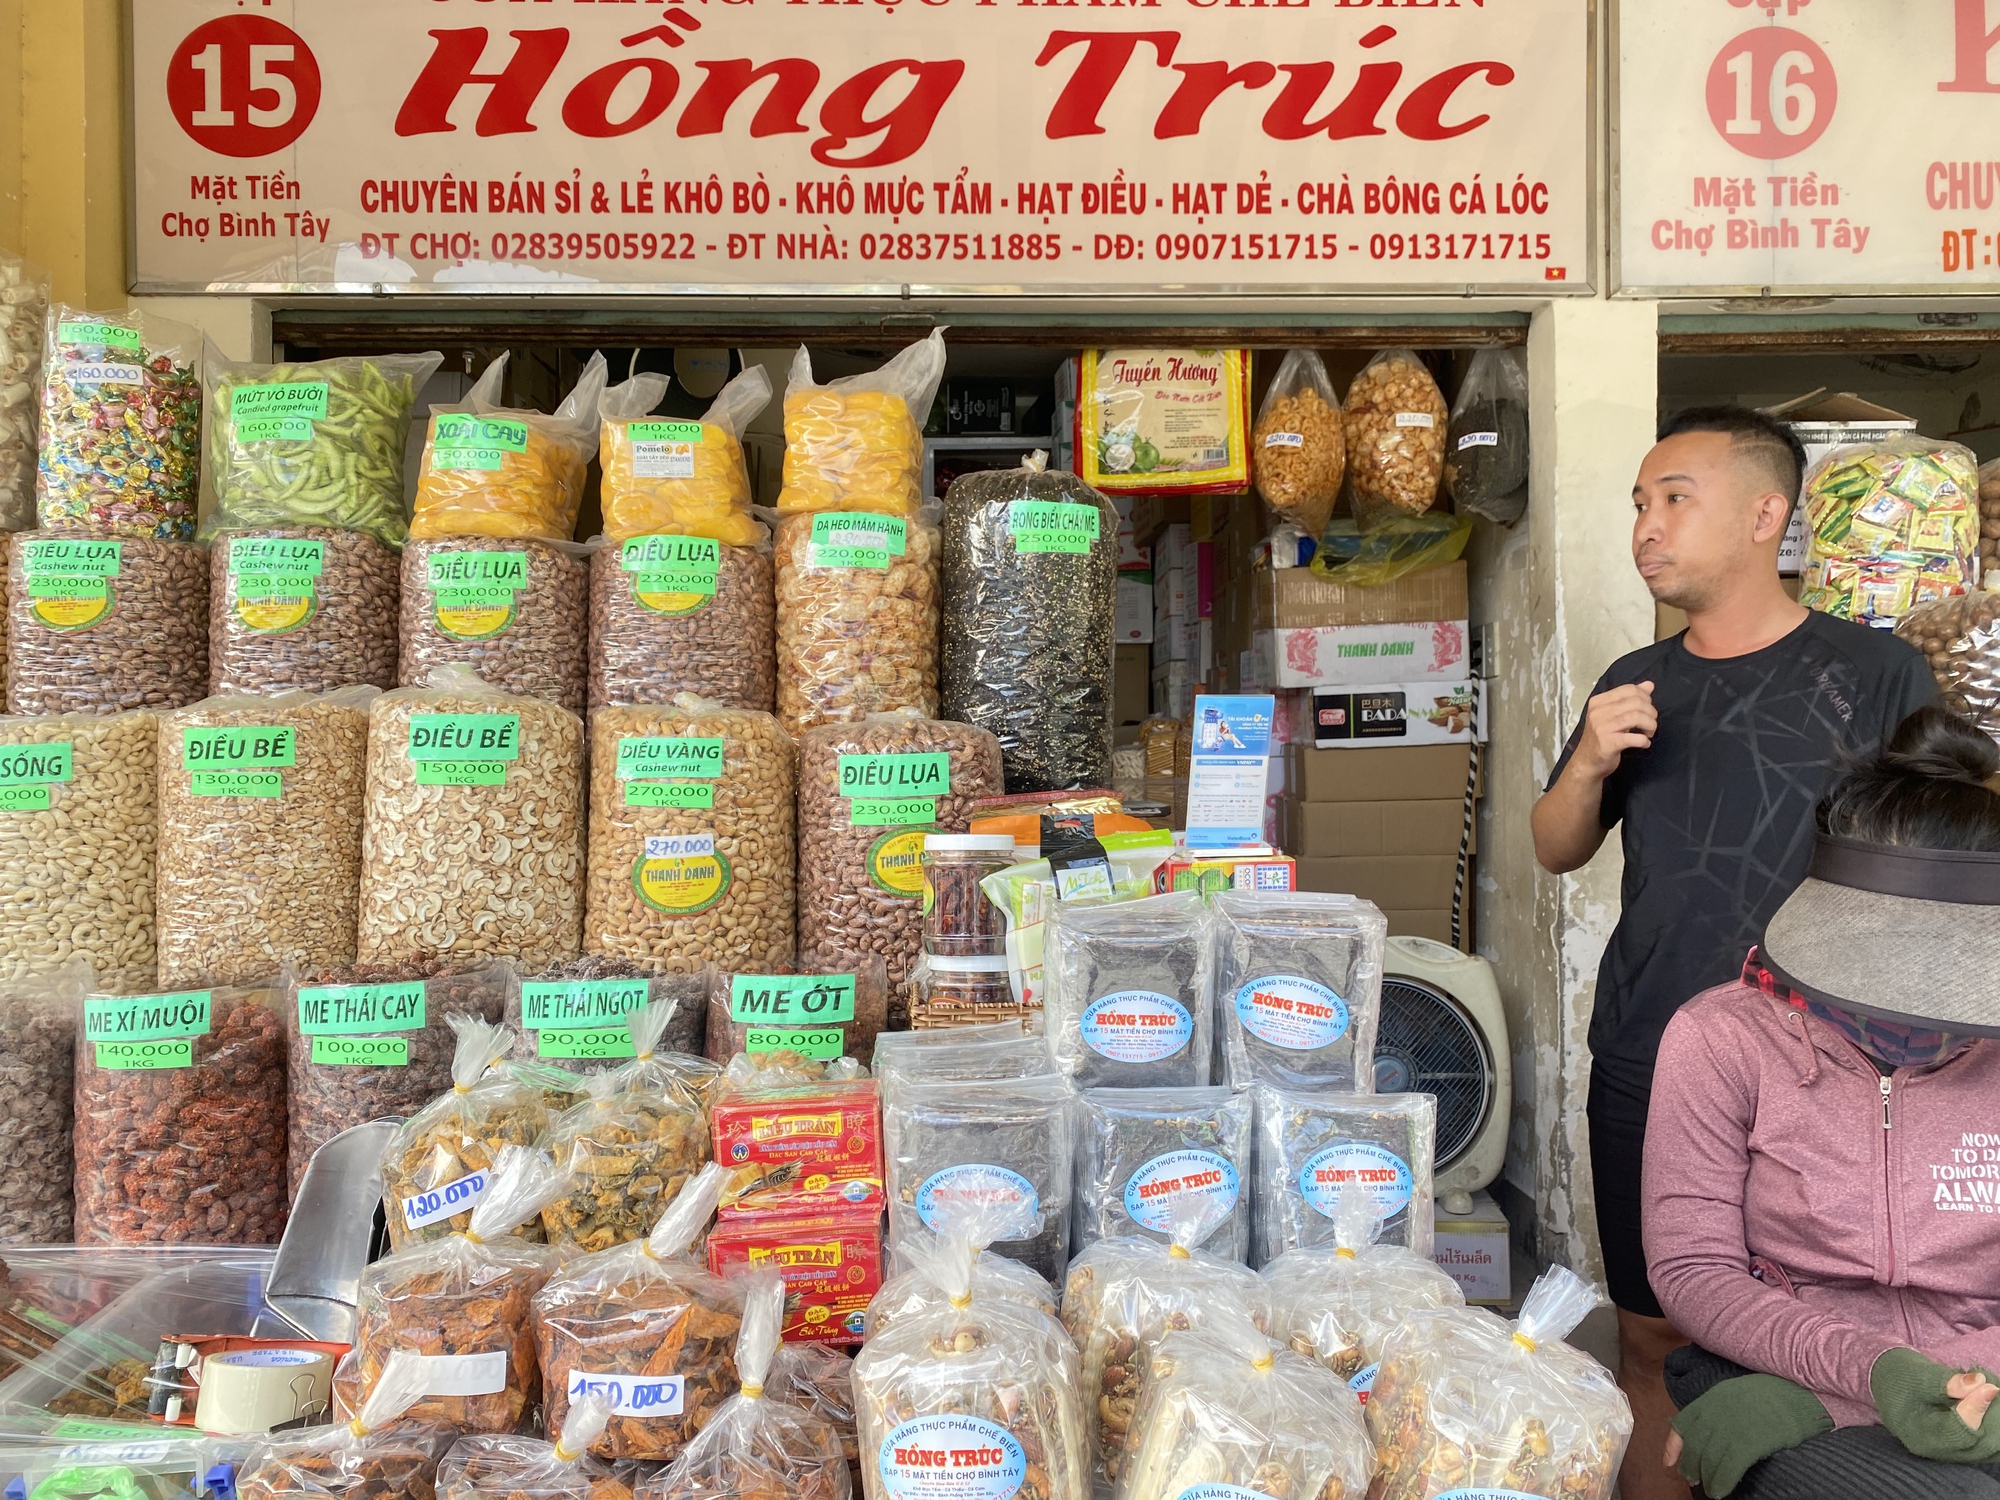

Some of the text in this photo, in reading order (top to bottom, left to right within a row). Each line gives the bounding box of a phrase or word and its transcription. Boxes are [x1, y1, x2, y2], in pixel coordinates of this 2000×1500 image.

[191, 44, 295, 127] 15
[394, 8, 1515, 168] Hồng Trúc
[1726, 50, 1817, 136] 16
[191, 169, 300, 205] Mặt Tiền
[360, 165, 1549, 224] CHUYÊN BÁN SỈ & LẺ KHÔ BÒ KHÔ MỰC TẨM HẠT ĐIỀU HẠT DẺ CHÀ BÔNG CÁ LÓC
[1693, 172, 1839, 215] Mặt Tiền
[161, 210, 330, 244] Chợ Bình Tây
[360, 224, 1551, 266] ĐT CHỢ: 02839505922 ĐT NHÀ: 02837511885 DĐ: 0907151715 0913171715
[1651, 217, 1870, 257] Chợ Bình Tây
[63, 324, 138, 341] 160.000
[78, 367, 139, 381] 160.000
[1167, 357, 1219, 387] Hương
[235, 387, 323, 404] MỨT VỎ BƯỞI
[237, 403, 318, 415] Candied grapefruit
[240, 421, 307, 434] 160.000
[631, 423, 700, 434] 140.000
[636, 445, 670, 453] Pomelo
[816, 519, 829, 531] DA
[830, 519, 850, 531] HEO
[877, 520, 904, 537] HÀNH
[1012, 511, 1039, 529] RONG
[1020, 534, 1087, 544] 250.000
[75, 546, 117, 562] LỤA
[281, 546, 320, 562] LỤA
[626, 538, 716, 566] ĐIỀU LỤA
[817, 549, 887, 561] 220.000
[34, 562, 105, 571] Cashew nut
[239, 560, 309, 571] Cashew nut
[432, 556, 522, 583] ĐIỀU LỤA
[32, 578, 104, 588] 230.000
[240, 578, 312, 588] 230.000
[641, 574, 713, 585] 220.000
[263, 588, 287, 596] 1KG
[439, 587, 511, 598] 230.000
[1337, 641, 1415, 658] THANH DANH
[413, 720, 515, 749] ĐIỀU BỂ
[189, 730, 289, 760] ĐIỀU BỂ
[620, 738, 720, 760] ĐIỀU VÀNG
[1, 750, 63, 778] SỐNG
[420, 762, 504, 774] 150.000
[680, 763, 701, 773] nut
[195, 774, 278, 786] 130.000
[447, 776, 475, 784] 1KG
[843, 759, 940, 792] ĐIỀU LỤA
[220, 787, 248, 795] 1KG
[628, 785, 708, 797] 270.000
[654, 799, 680, 807] 1KG
[855, 803, 934, 815] 230.000
[882, 815, 908, 824] 1KG
[646, 839, 711, 856] 270.000
[645, 866, 715, 882] THANH DANH
[528, 995, 550, 1019] ME
[554, 988, 592, 1018] THÁI
[740, 983, 849, 1014] ME ỚT
[1252, 990, 1333, 1019] HỒNG TRÚC
[304, 994, 420, 1024] ME THÁI CAY
[88, 1002, 205, 1033] ME XÍ MUỘI
[1096, 1009, 1176, 1026] HỒNG TRÚC
[316, 1041, 406, 1054] 100.000
[749, 1033, 840, 1046] 80.000
[98, 1043, 189, 1056] 140.000
[570, 1048, 606, 1056] 1KG
[123, 1059, 154, 1068] 1KG
[343, 1057, 375, 1065] 1KG
[1962, 1132, 2000, 1147] NOW
[1951, 1148, 1978, 1163] TO
[1358, 1166, 1396, 1182] TRÚC
[1929, 1164, 2000, 1180] TOMOR
[1139, 1168, 1221, 1198] HỒNG TRÚC
[407, 1175, 484, 1219] 120.000
[1936, 1203, 1993, 1213] LEARN TO
[894, 1442, 1002, 1467] HỒNG TRÚC
